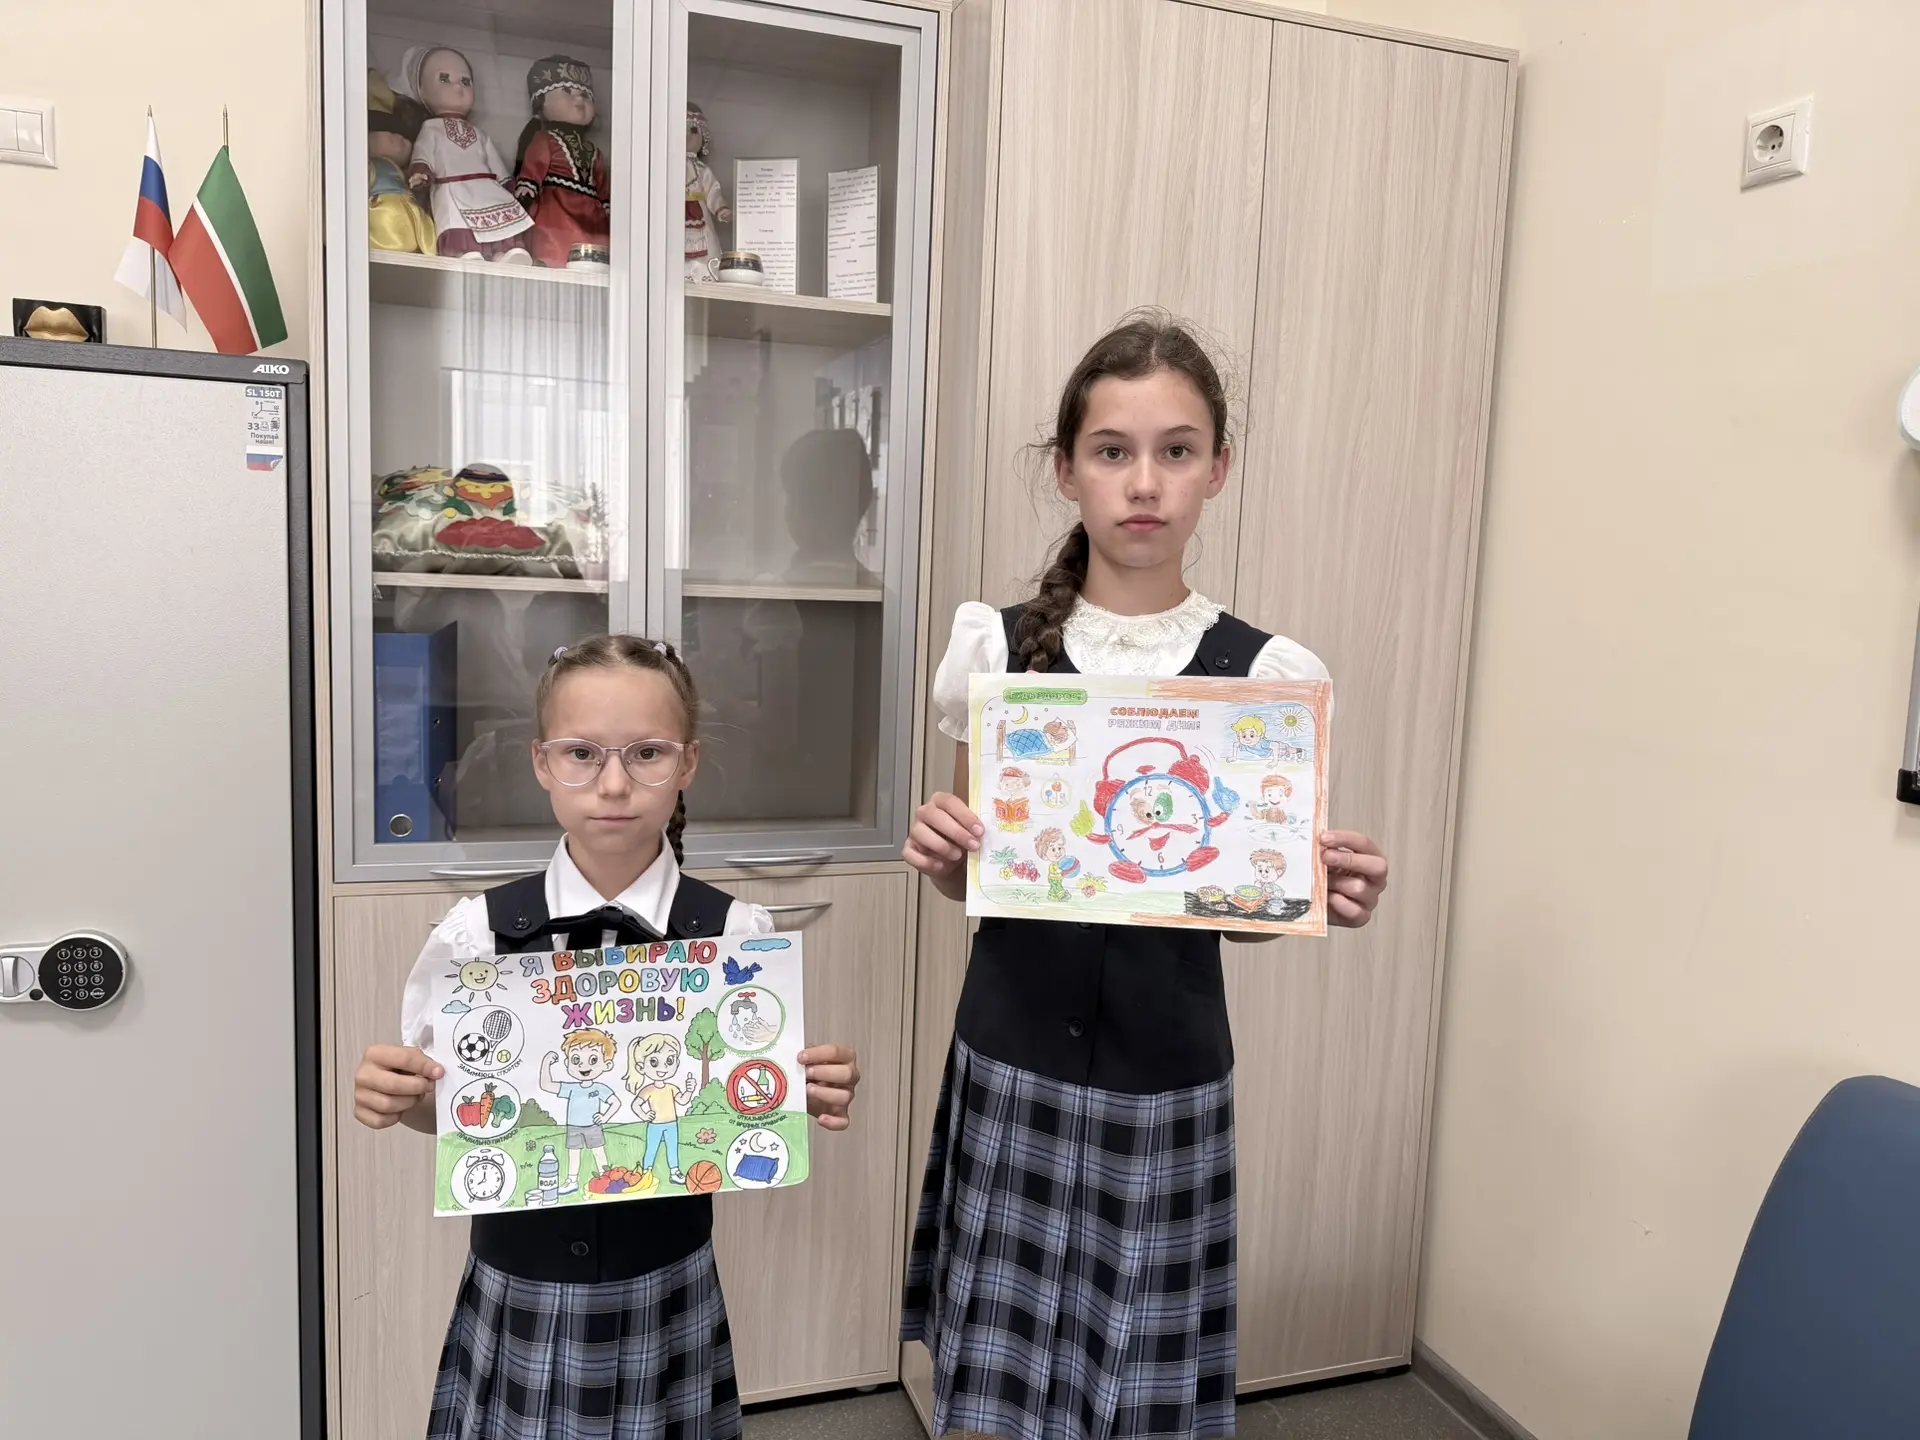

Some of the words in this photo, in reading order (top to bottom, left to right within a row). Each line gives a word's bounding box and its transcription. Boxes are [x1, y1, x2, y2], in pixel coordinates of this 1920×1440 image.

[252, 364, 290, 375] AIKO
[246, 388, 258, 397] SL
[260, 389, 281, 399] 150T
[247, 422, 260, 431] 33
[250, 432, 280, 441] Покупай
[1110, 706, 1200, 719] СОБЛЮДАЕМ
[1107, 718, 1161, 730] РЕЖИМ
[1166, 720, 1201, 731] ДНЯ!
[1144, 785, 1153, 797] 12
[1191, 813, 1199, 825] 3
[1116, 823, 1124, 836] 9
[1157, 851, 1165, 864] 6
[519, 955, 545, 978] Я
[552, 940, 718, 972] ВЫБИРАЮ
[530, 967, 710, 1005] ЗДОРОВУЮ
[561, 996, 685, 1029] ЖИЗНЬ!
[539, 1179, 557, 1187] ВОДА
